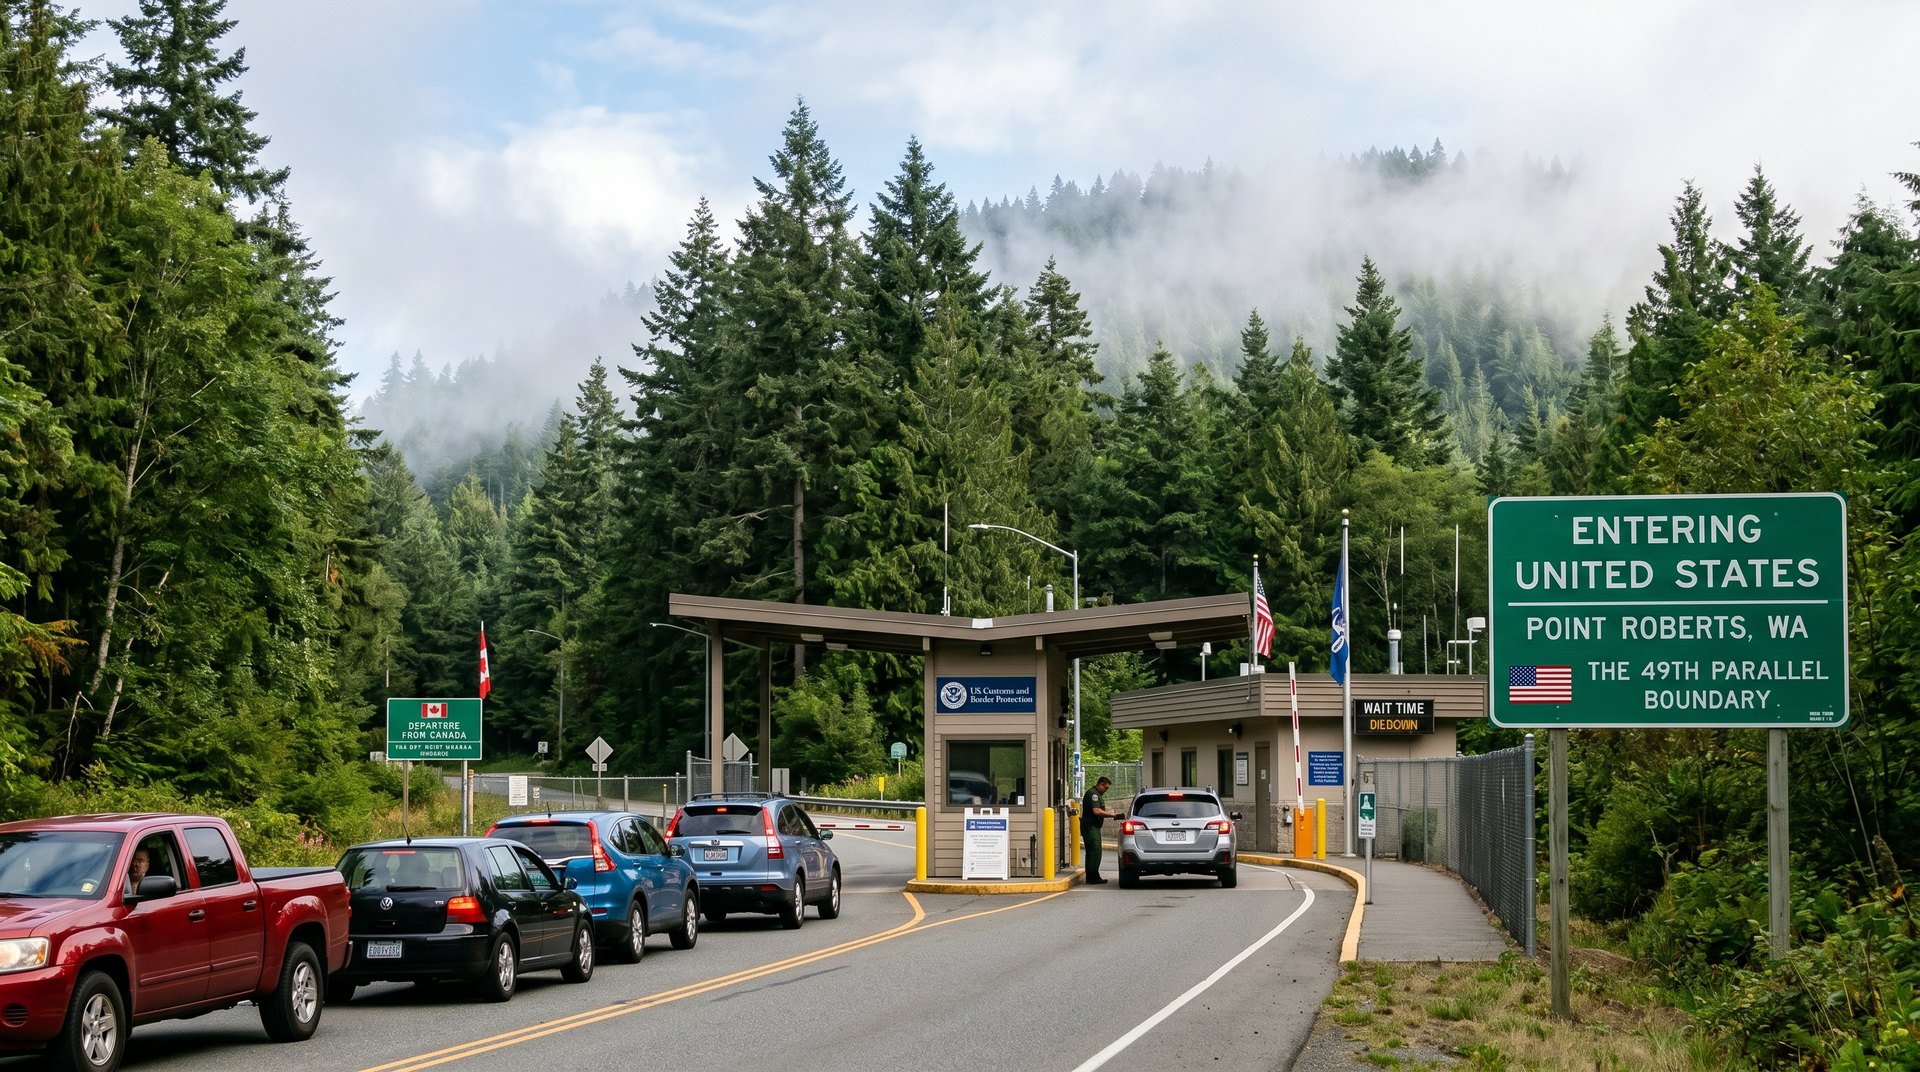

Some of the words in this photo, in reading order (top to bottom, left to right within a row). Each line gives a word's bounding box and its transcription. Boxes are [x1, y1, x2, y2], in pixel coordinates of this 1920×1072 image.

[1572, 514, 1762, 545] ENTERING
[1516, 560, 1654, 590] UNITED
[1674, 558, 1820, 589] STATES
[1527, 616, 1607, 641] POINT
[1622, 615, 1753, 642] ROBERTS,
[1767, 615, 1809, 639] WA
[1587, 661, 1630, 681] THE
[1641, 661, 1699, 680] 49TH
[1712, 660, 1829, 680] PARALLEL
[970, 695, 994, 704] Border
[995, 695, 1033, 704] Protection
[982, 687, 1015, 695] Customs
[1015, 686, 1030, 695] and
[1644, 689, 1771, 710] BOUNDARY
[1363, 702, 1393, 715] WAIT
[1395, 702, 1425, 715] TIME
[401, 731, 426, 739] FROM
[429, 731, 467, 739] CANADA
